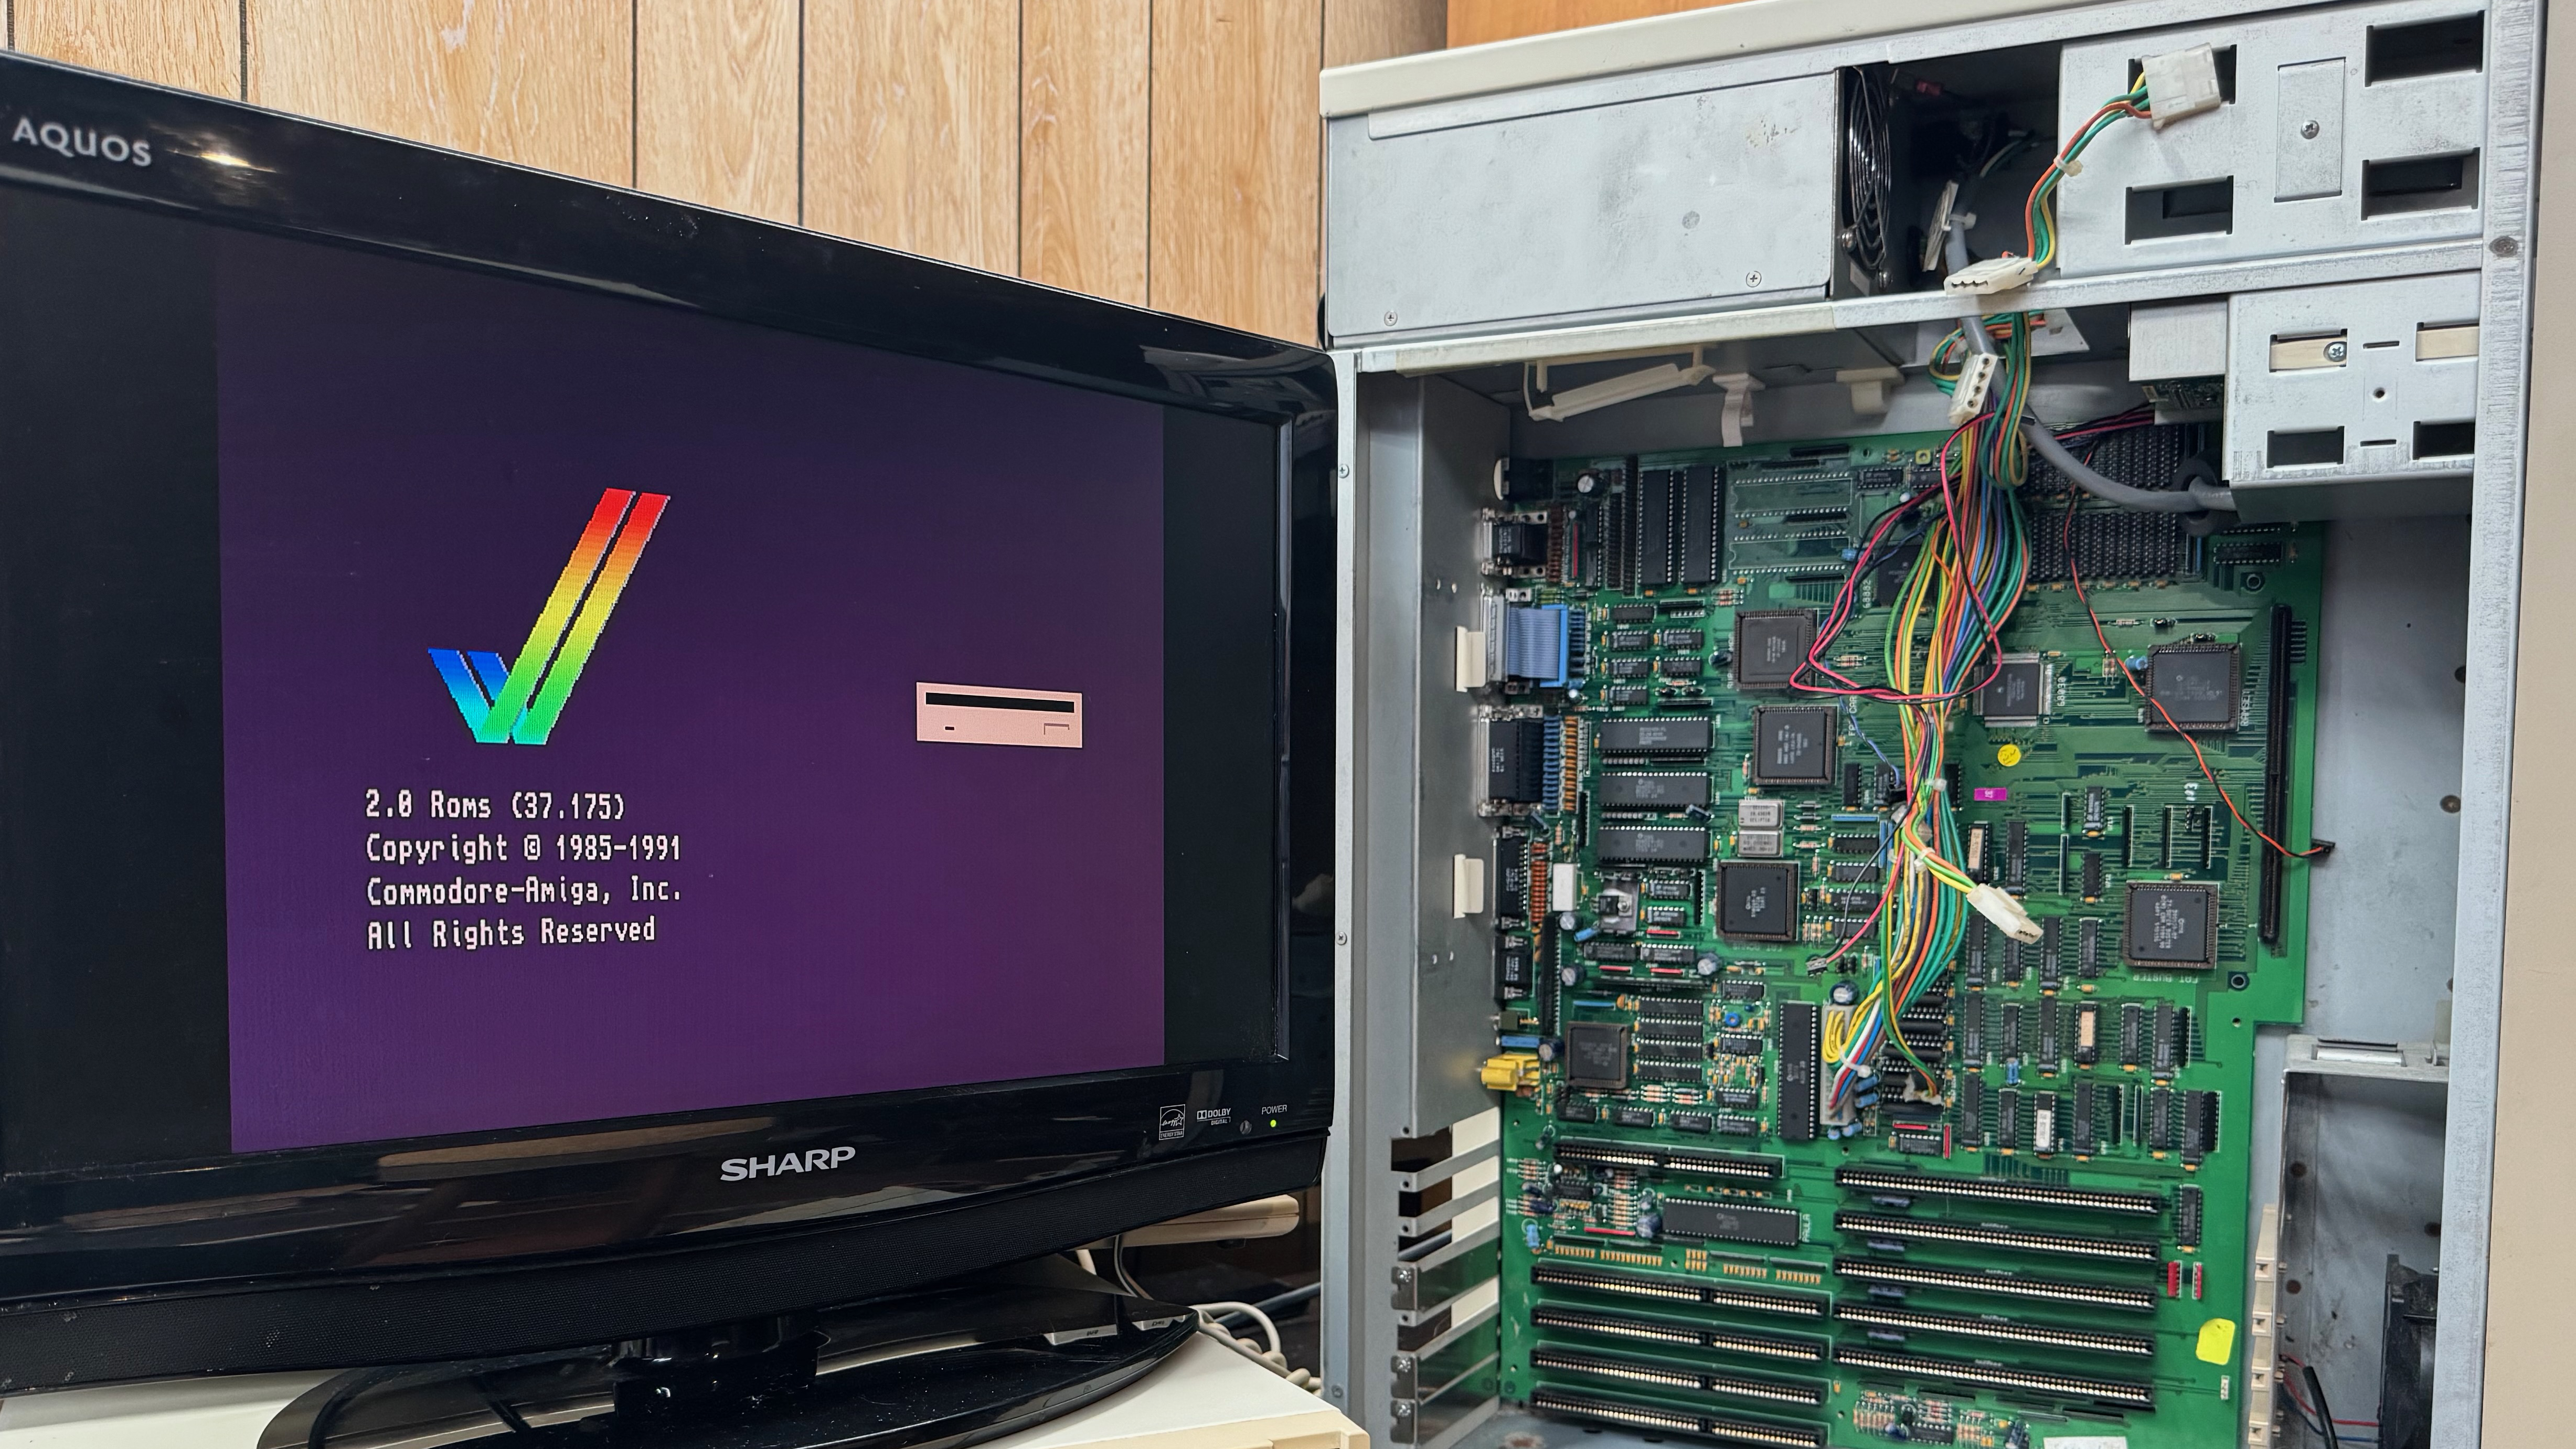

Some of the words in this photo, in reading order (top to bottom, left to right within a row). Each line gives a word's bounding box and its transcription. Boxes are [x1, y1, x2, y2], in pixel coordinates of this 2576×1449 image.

[12, 116, 152, 167] AQUOS
[1862, 580, 1871, 609] 68882
[2057, 677, 2067, 707] 68030
[2240, 689, 2250, 727] RAMSEY
[366, 789, 412, 817] 2.0
[431, 790, 491, 818] Roms
[512, 792, 624, 819] (37.175)
[367, 833, 507, 865] Copyright
[524, 834, 541, 860] ©
[557, 834, 679, 860] 1985-1991
[367, 876, 610, 905] Commodore-Amiga,
[631, 875, 680, 901] Inc.
[368, 921, 411, 950] All
[433, 919, 524, 950] Rights
[541, 915, 655, 944] Reserved
[1208, 1107, 1231, 1118] DOLBY
[1261, 1104, 1287, 1115] POWER
[720, 1146, 856, 1181] SHARP
